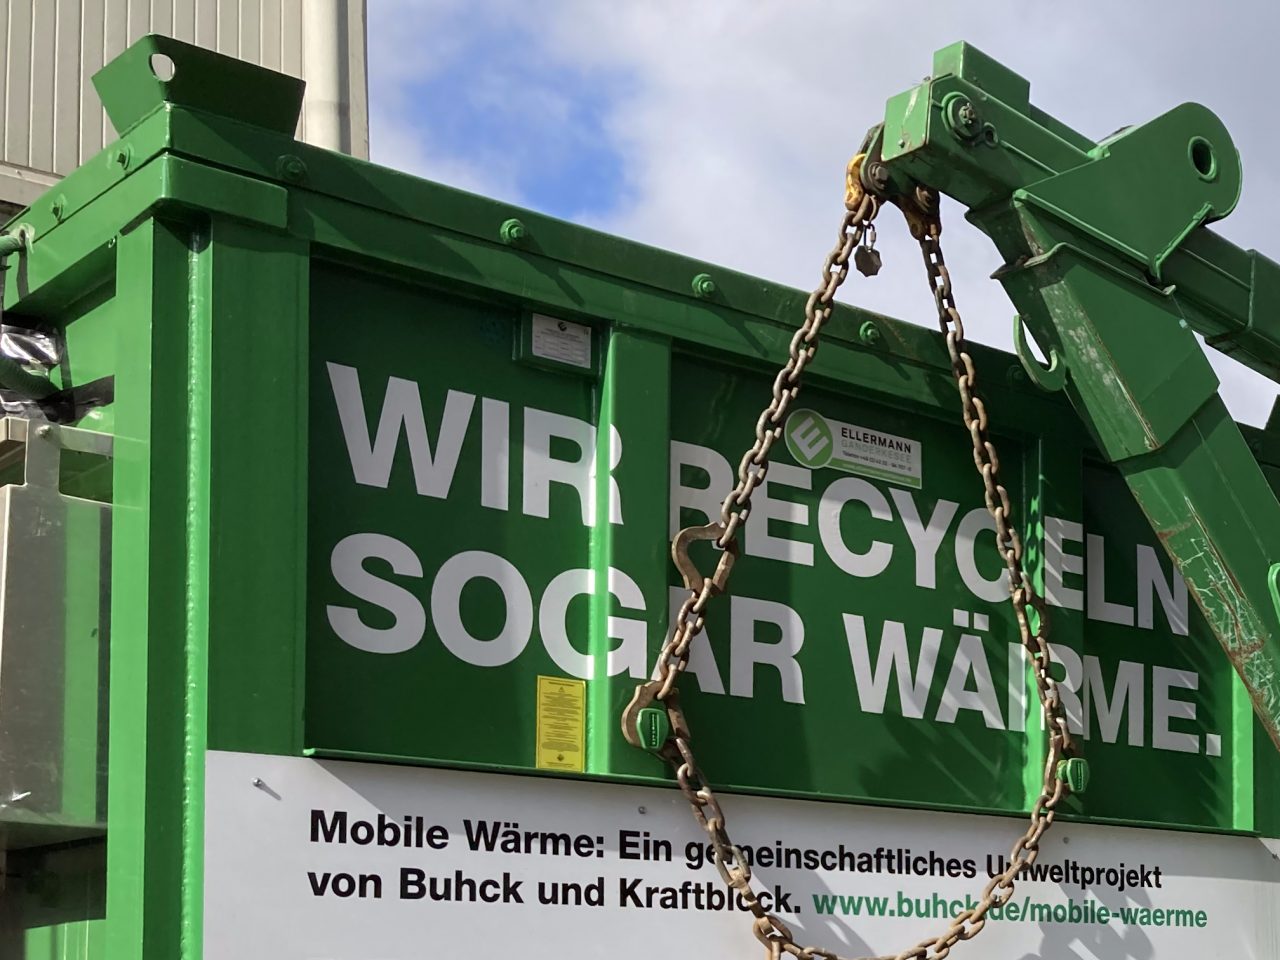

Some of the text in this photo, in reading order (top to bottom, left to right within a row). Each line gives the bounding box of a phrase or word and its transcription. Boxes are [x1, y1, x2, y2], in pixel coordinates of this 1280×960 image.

[841, 427, 911, 453] ELLERMANN
[325, 360, 1189, 637] WIR RECYCELN
[325, 532, 1222, 757] SOGAR WÄRME.
[309, 809, 450, 850] Mobile
[463, 818, 605, 858] Wärme:
[618, 829, 673, 862] Ein
[307, 867, 1208, 928] von Buhck und Kraftblock. www.buhckde/mobile-waerme
